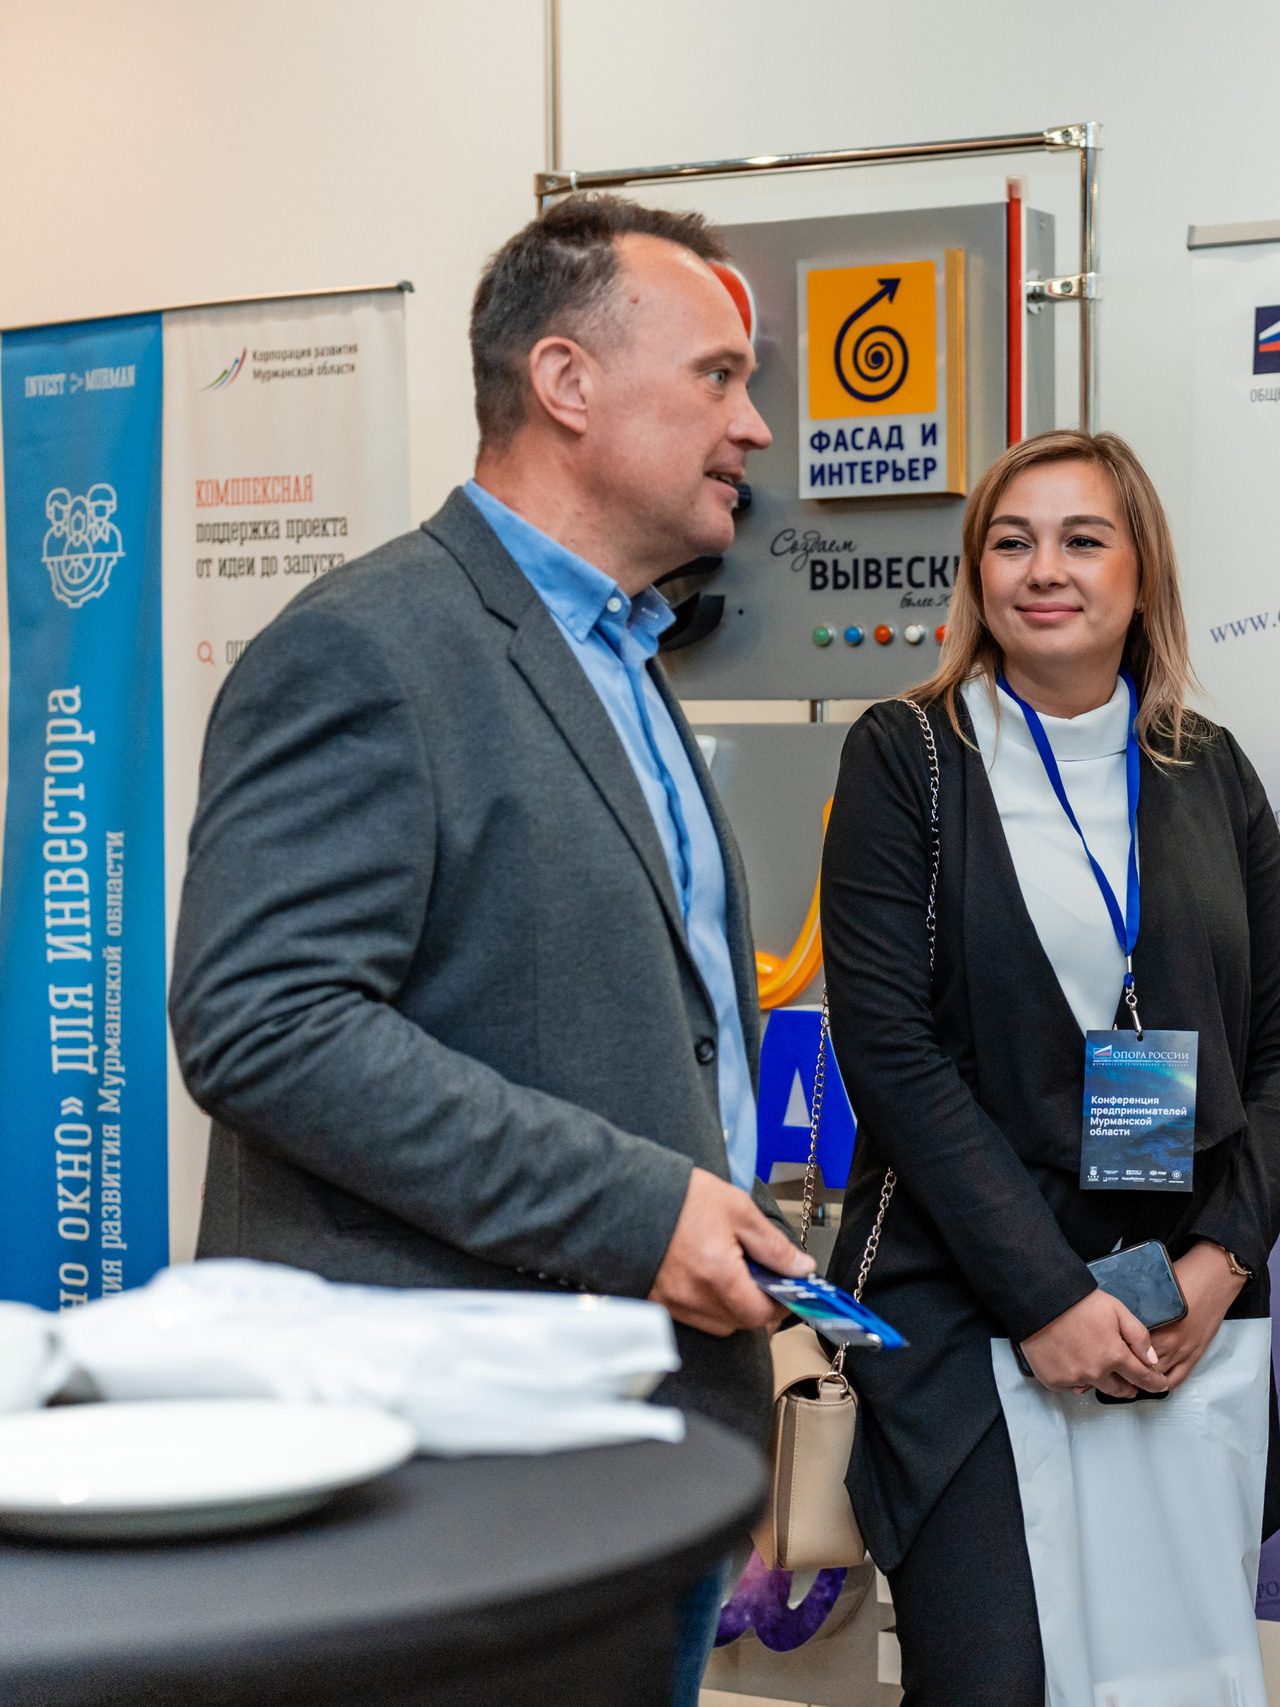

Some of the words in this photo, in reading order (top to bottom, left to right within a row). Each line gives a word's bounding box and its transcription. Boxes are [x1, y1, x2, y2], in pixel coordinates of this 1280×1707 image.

[252, 347, 312, 363] Корпорация
[314, 343, 358, 359] развития
[252, 363, 314, 383] Мурманской
[316, 361, 356, 376] области
[810, 425, 905, 453] ФАСАД
[921, 422, 938, 446] И
[810, 456, 937, 487] ИНТЕРЬЕР
[195, 473, 314, 509] КОМПЛЕКСНАЯ
[196, 519, 281, 546] поддержка
[286, 516, 348, 545] проекта
[195, 557, 213, 579] от
[218, 555, 256, 579] идеи
[260, 555, 279, 578] до
[105, 830, 125, 937] области
[97, 947, 128, 1115] Мурманской
[1112, 1051, 1147, 1060] ОПОРА
[1148, 1051, 1189, 1060] РОССИИ
[1090, 1106, 1187, 1116] предпринимателей
[1091, 1095, 1160, 1106] Конференция
[1089, 1127, 1131, 1136] области
[1090, 1116, 1152, 1127] Мурманской
[101, 1123, 128, 1250] развития
